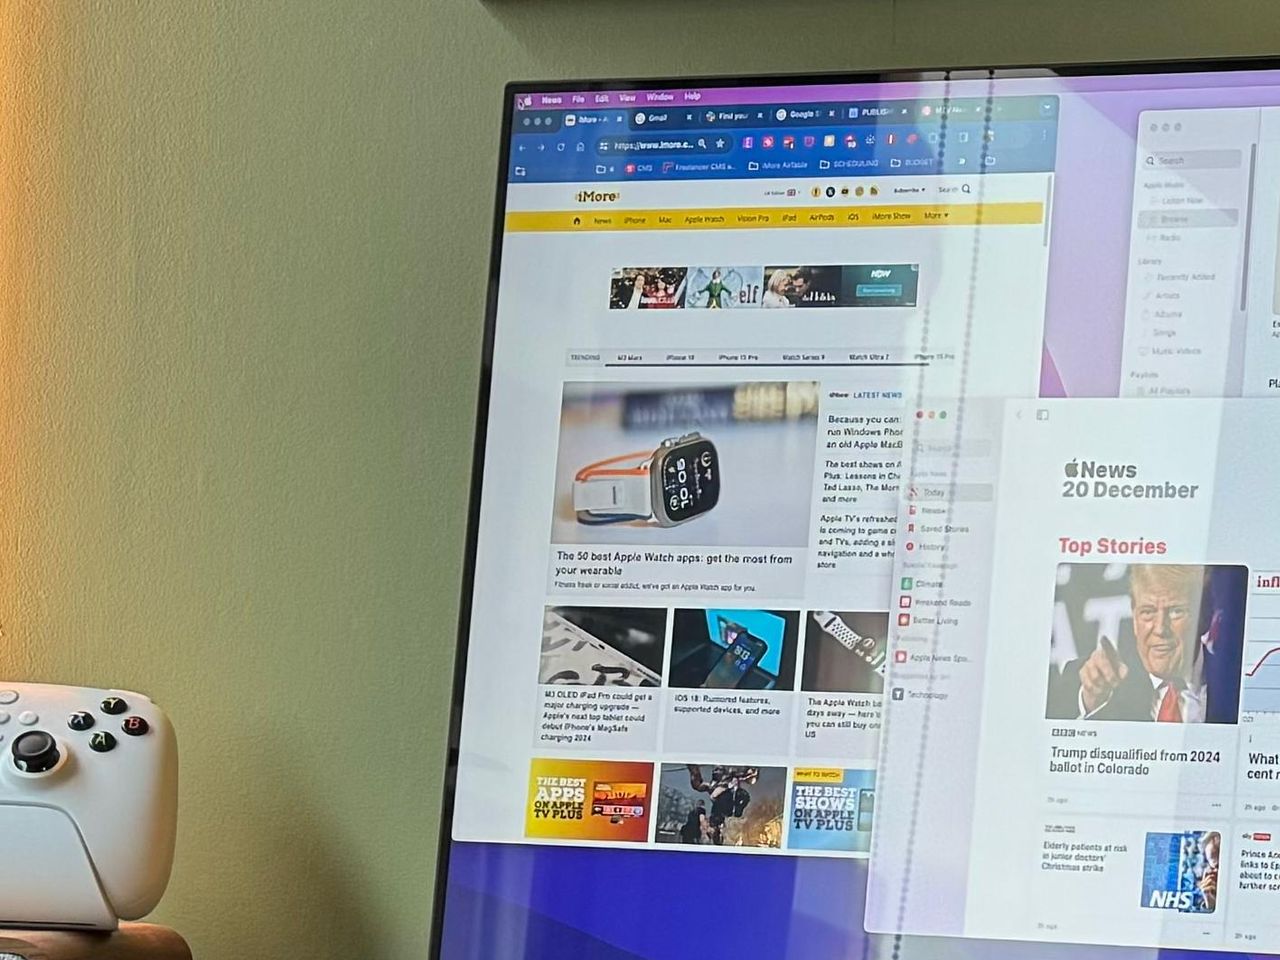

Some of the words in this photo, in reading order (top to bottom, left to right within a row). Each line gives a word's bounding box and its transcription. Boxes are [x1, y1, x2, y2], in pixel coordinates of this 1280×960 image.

[542, 96, 562, 105] News
[572, 95, 585, 103] File
[595, 94, 609, 103] Edit
[620, 94, 636, 102] View
[647, 92, 674, 101] Window
[684, 92, 701, 101] Help
[578, 191, 617, 202] iMore
[624, 216, 646, 224] iPhone
[739, 284, 758, 304] elf
[828, 416, 864, 424] Because
[866, 416, 882, 425] you
[844, 427, 881, 436] Windows
[839, 440, 852, 449] old
[854, 440, 878, 449] Apple
[1081, 461, 1137, 478] News
[1062, 481, 1089, 498] 20
[1094, 481, 1199, 498] December
[1059, 537, 1092, 557] Top
[1097, 537, 1167, 555] Stories
[557, 551, 574, 561] The
[577, 552, 588, 561] 50
[591, 552, 611, 561] best
[614, 552, 642, 563] Apple
[644, 552, 674, 563] Watch
[676, 554, 702, 564] apps:
[707, 554, 722, 565] get
[725, 553, 740, 563] the
[742, 554, 767, 564] most
[769, 554, 792, 564] from
[555, 566, 577, 577] your
[580, 566, 622, 576] wearable
[129, 718, 139, 728] B
[95, 733, 106, 745] A
[1052, 746, 1087, 759] Trump
[1090, 747, 1157, 761] disqualified
[1160, 750, 1187, 762] from
[1190, 750, 1220, 762] 2024
[1249, 753, 1279, 765] What
[1050, 761, 1082, 773] ballot
[1084, 762, 1094, 773] in
[1097, 762, 1149, 775] Colorado
[1247, 769, 1273, 780] cent
[537, 777, 556, 787] THE
[559, 777, 586, 788] BEST
[536, 787, 585, 801] APPS
[795, 786, 819, 797] THE
[821, 786, 857, 798] BEST
[535, 801, 550, 811] ON
[552, 801, 584, 811] APPLE
[795, 796, 856, 811] SHOWS
[534, 809, 549, 819] TV
[550, 809, 583, 820] PLUS
[794, 809, 812, 819] ON
[815, 809, 854, 820] APPLE
[794, 818, 813, 830] TV
[816, 819, 853, 831] PLUS
[1044, 841, 1069, 851] Elderly
[1071, 843, 1102, 851] patients
[1104, 844, 1112, 852] at
[1051, 853, 1072, 862] junior
[1241, 850, 1266, 858] Prince
[1042, 862, 1080, 871] Christmas
[1082, 863, 1104, 872] strike
[1241, 861, 1259, 869] links
[1240, 872, 1262, 880] about
[1264, 873, 1272, 881] to
[1150, 890, 1192, 908] NHS
